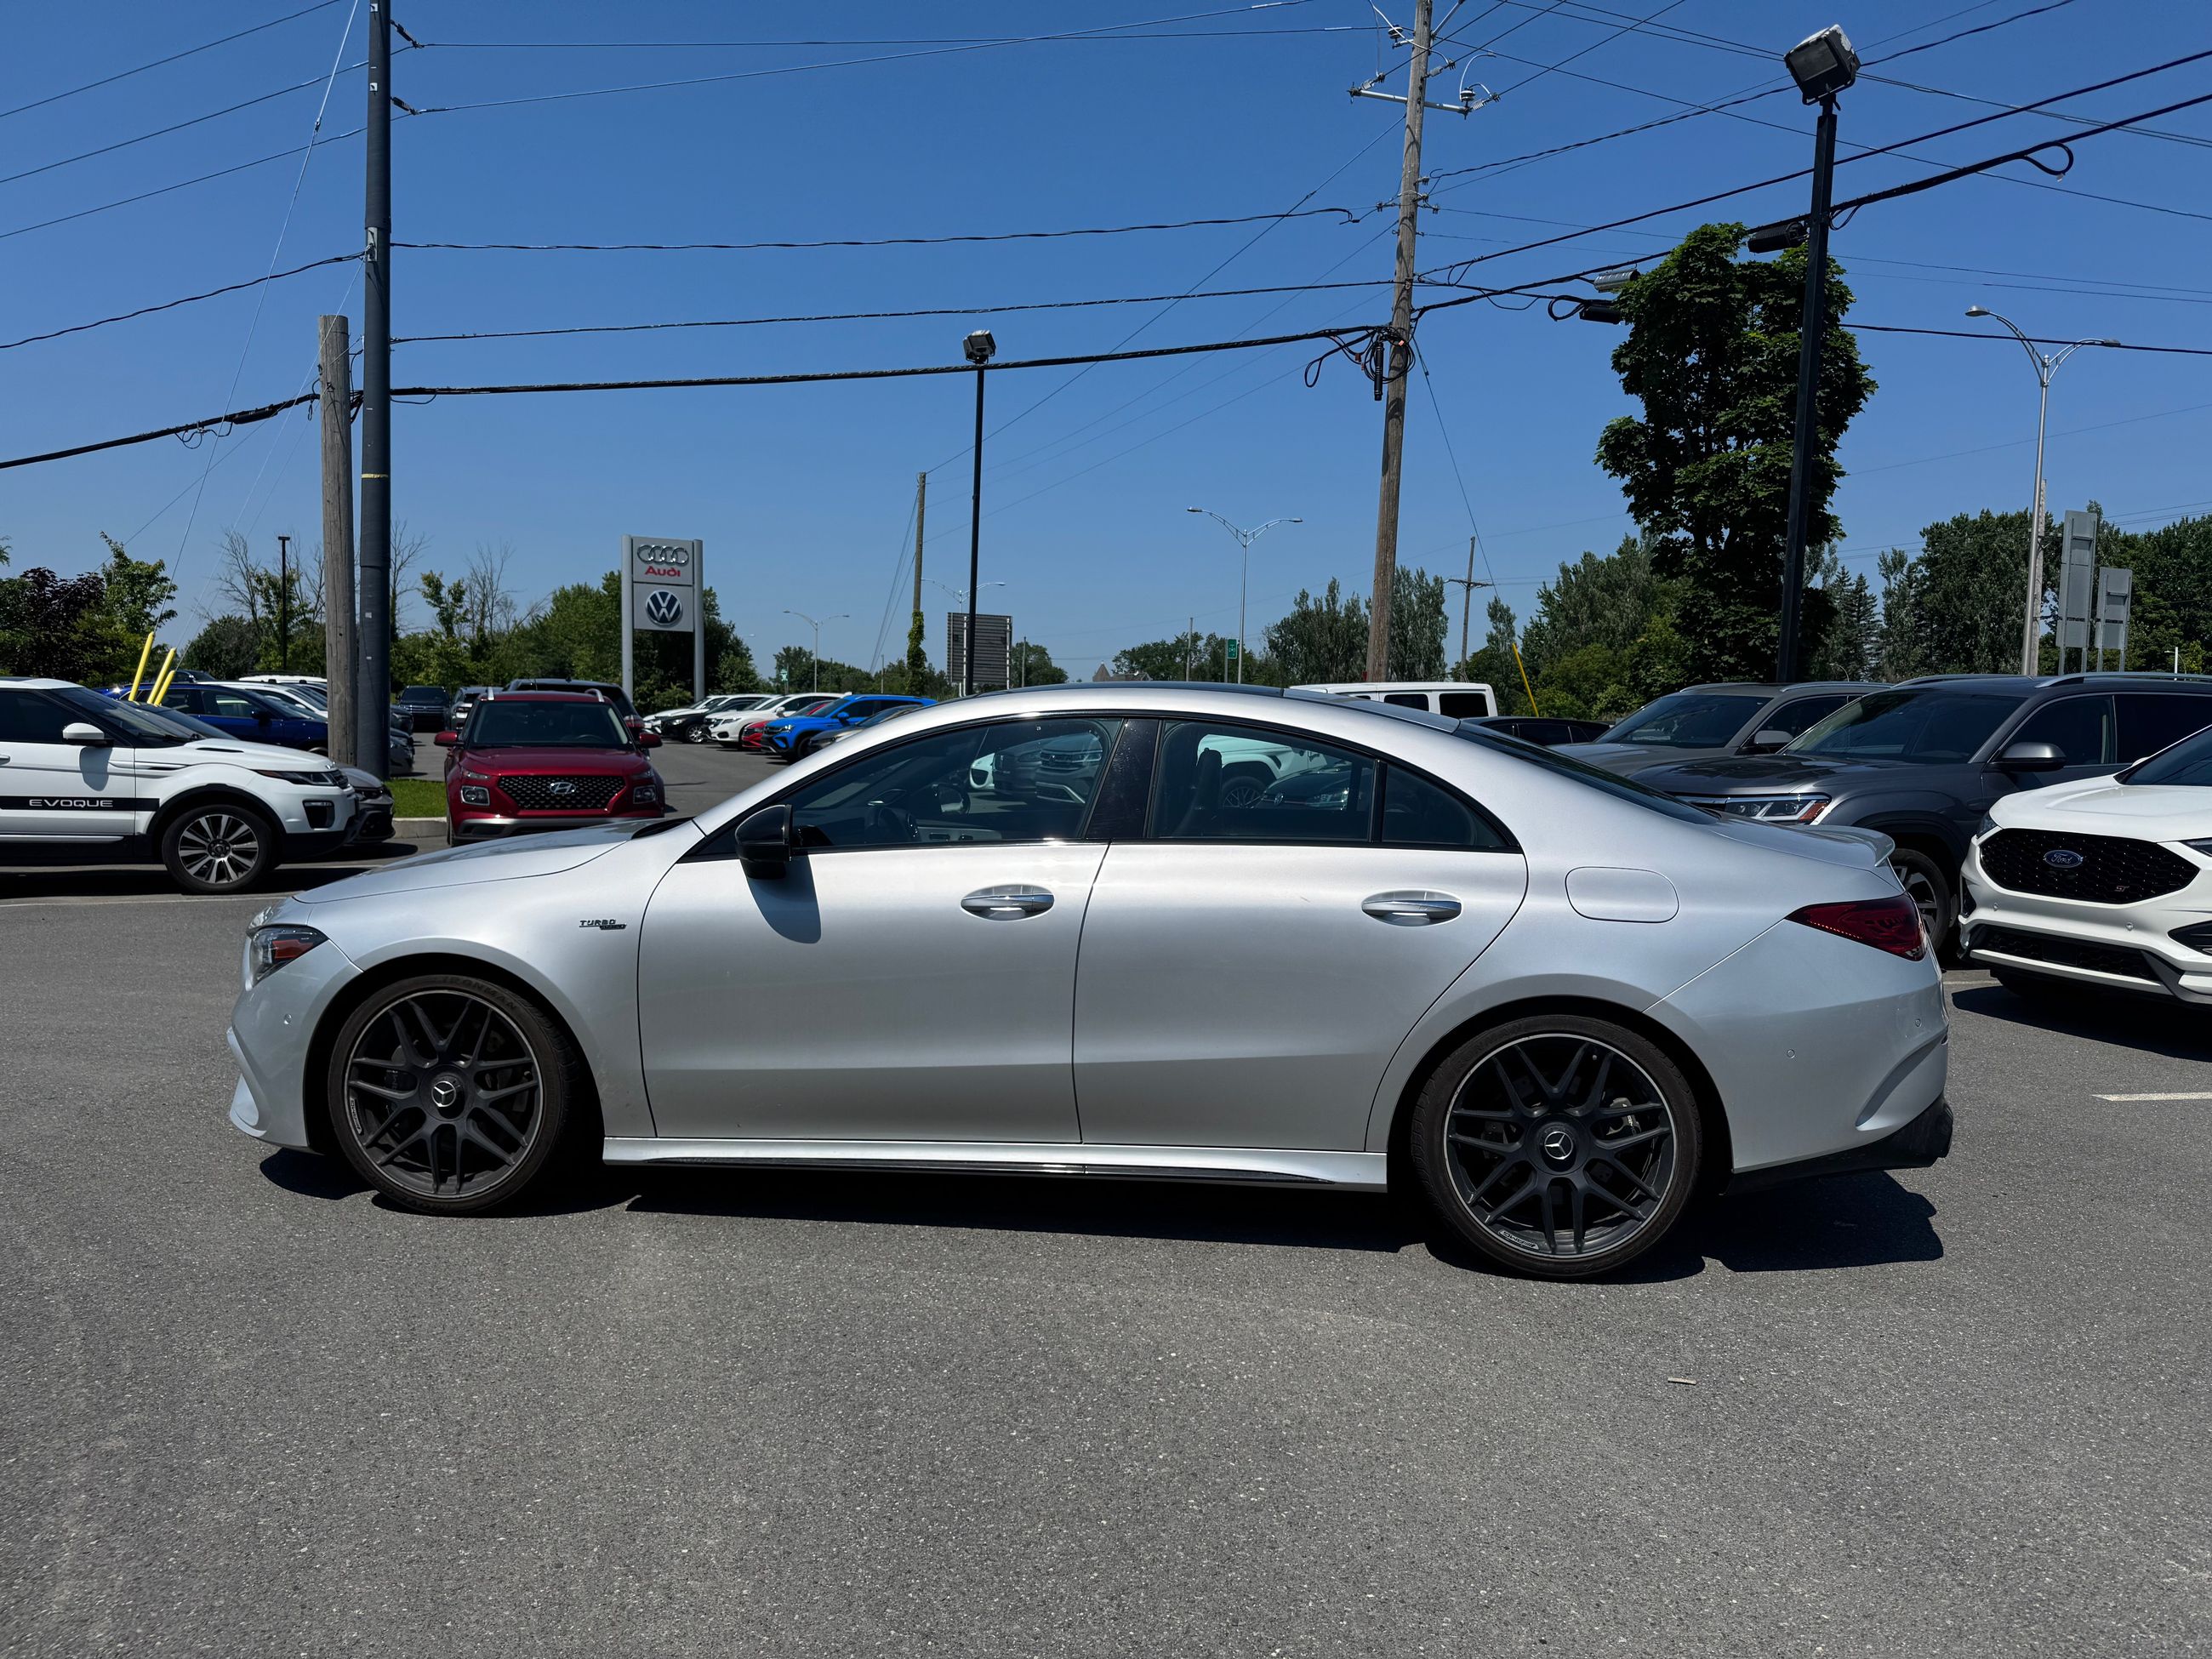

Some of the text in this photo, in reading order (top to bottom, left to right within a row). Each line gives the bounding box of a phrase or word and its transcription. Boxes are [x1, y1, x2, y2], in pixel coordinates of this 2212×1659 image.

[645, 566, 681, 577] Audi
[29, 799, 113, 808] EVOQUE
[2050, 852, 2072, 864] Ford
